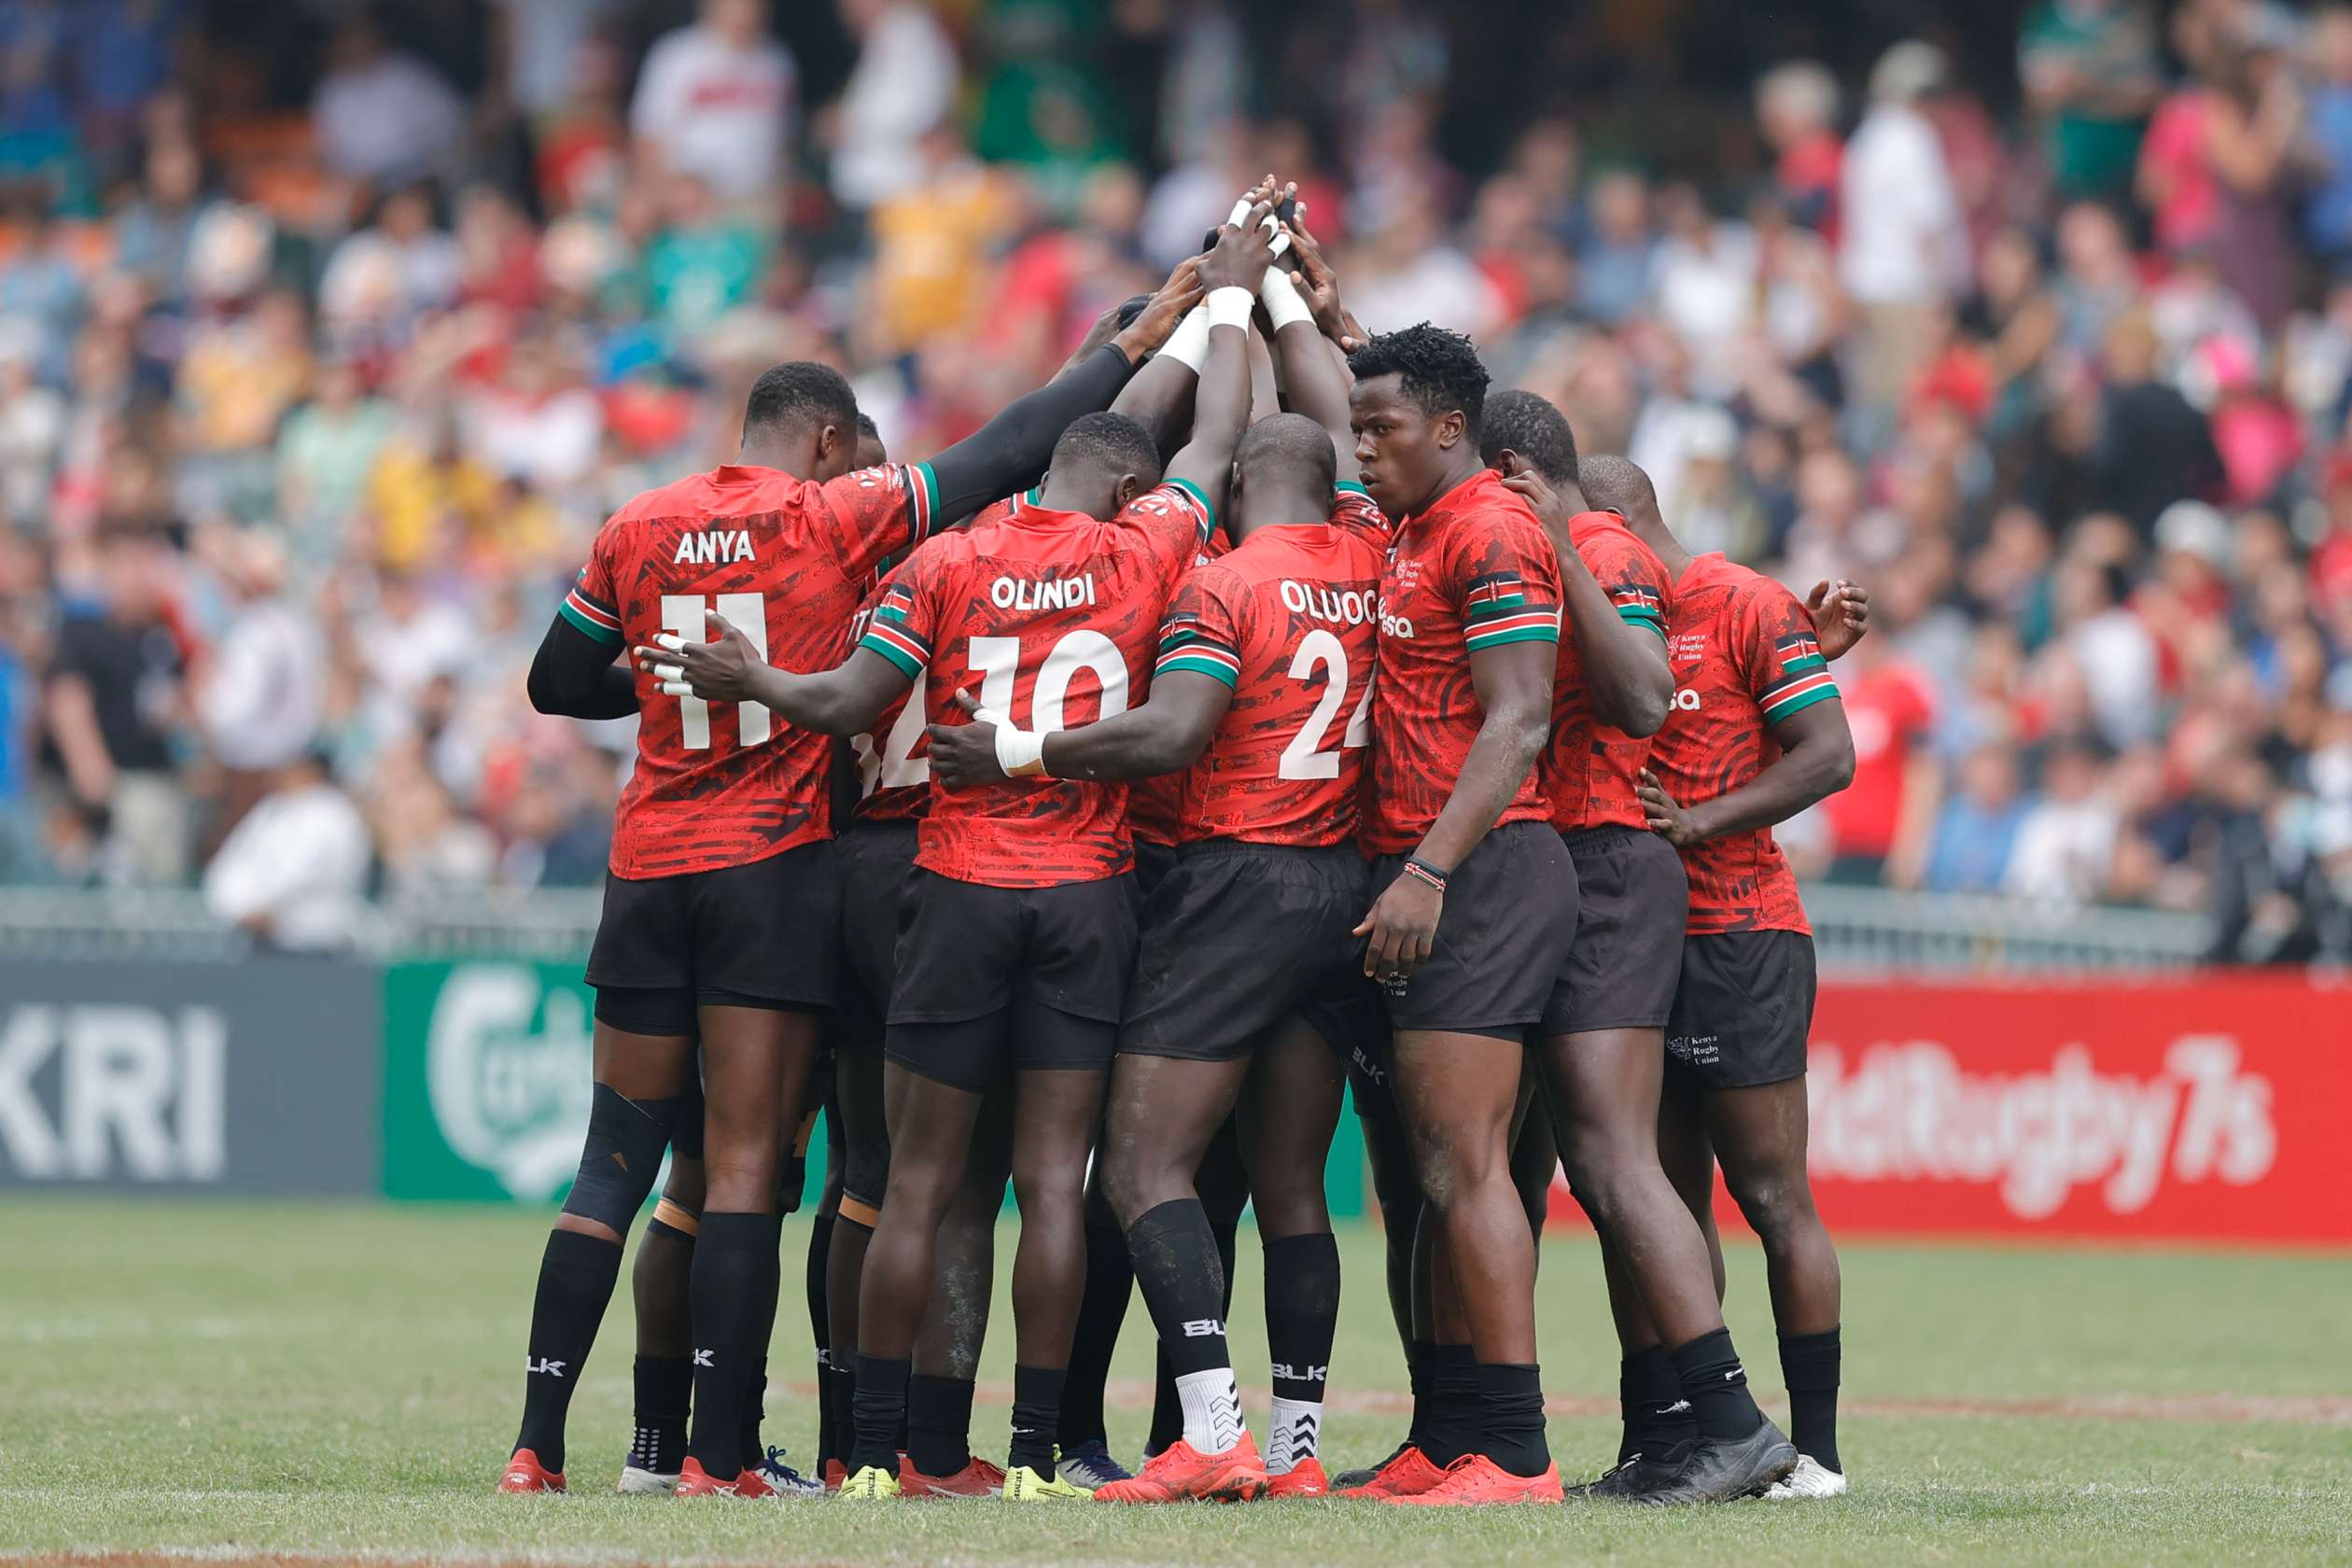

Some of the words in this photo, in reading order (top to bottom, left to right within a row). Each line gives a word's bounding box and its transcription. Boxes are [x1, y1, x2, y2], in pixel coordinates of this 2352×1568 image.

[673, 530, 756, 564] ANYA
[991, 573, 1096, 610] OLINDI
[660, 592, 771, 749] 11
[968, 629, 1129, 734] 10
[1691, 1036, 1717, 1045] Kenya
[1271, 1363, 1327, 1381] BLK
